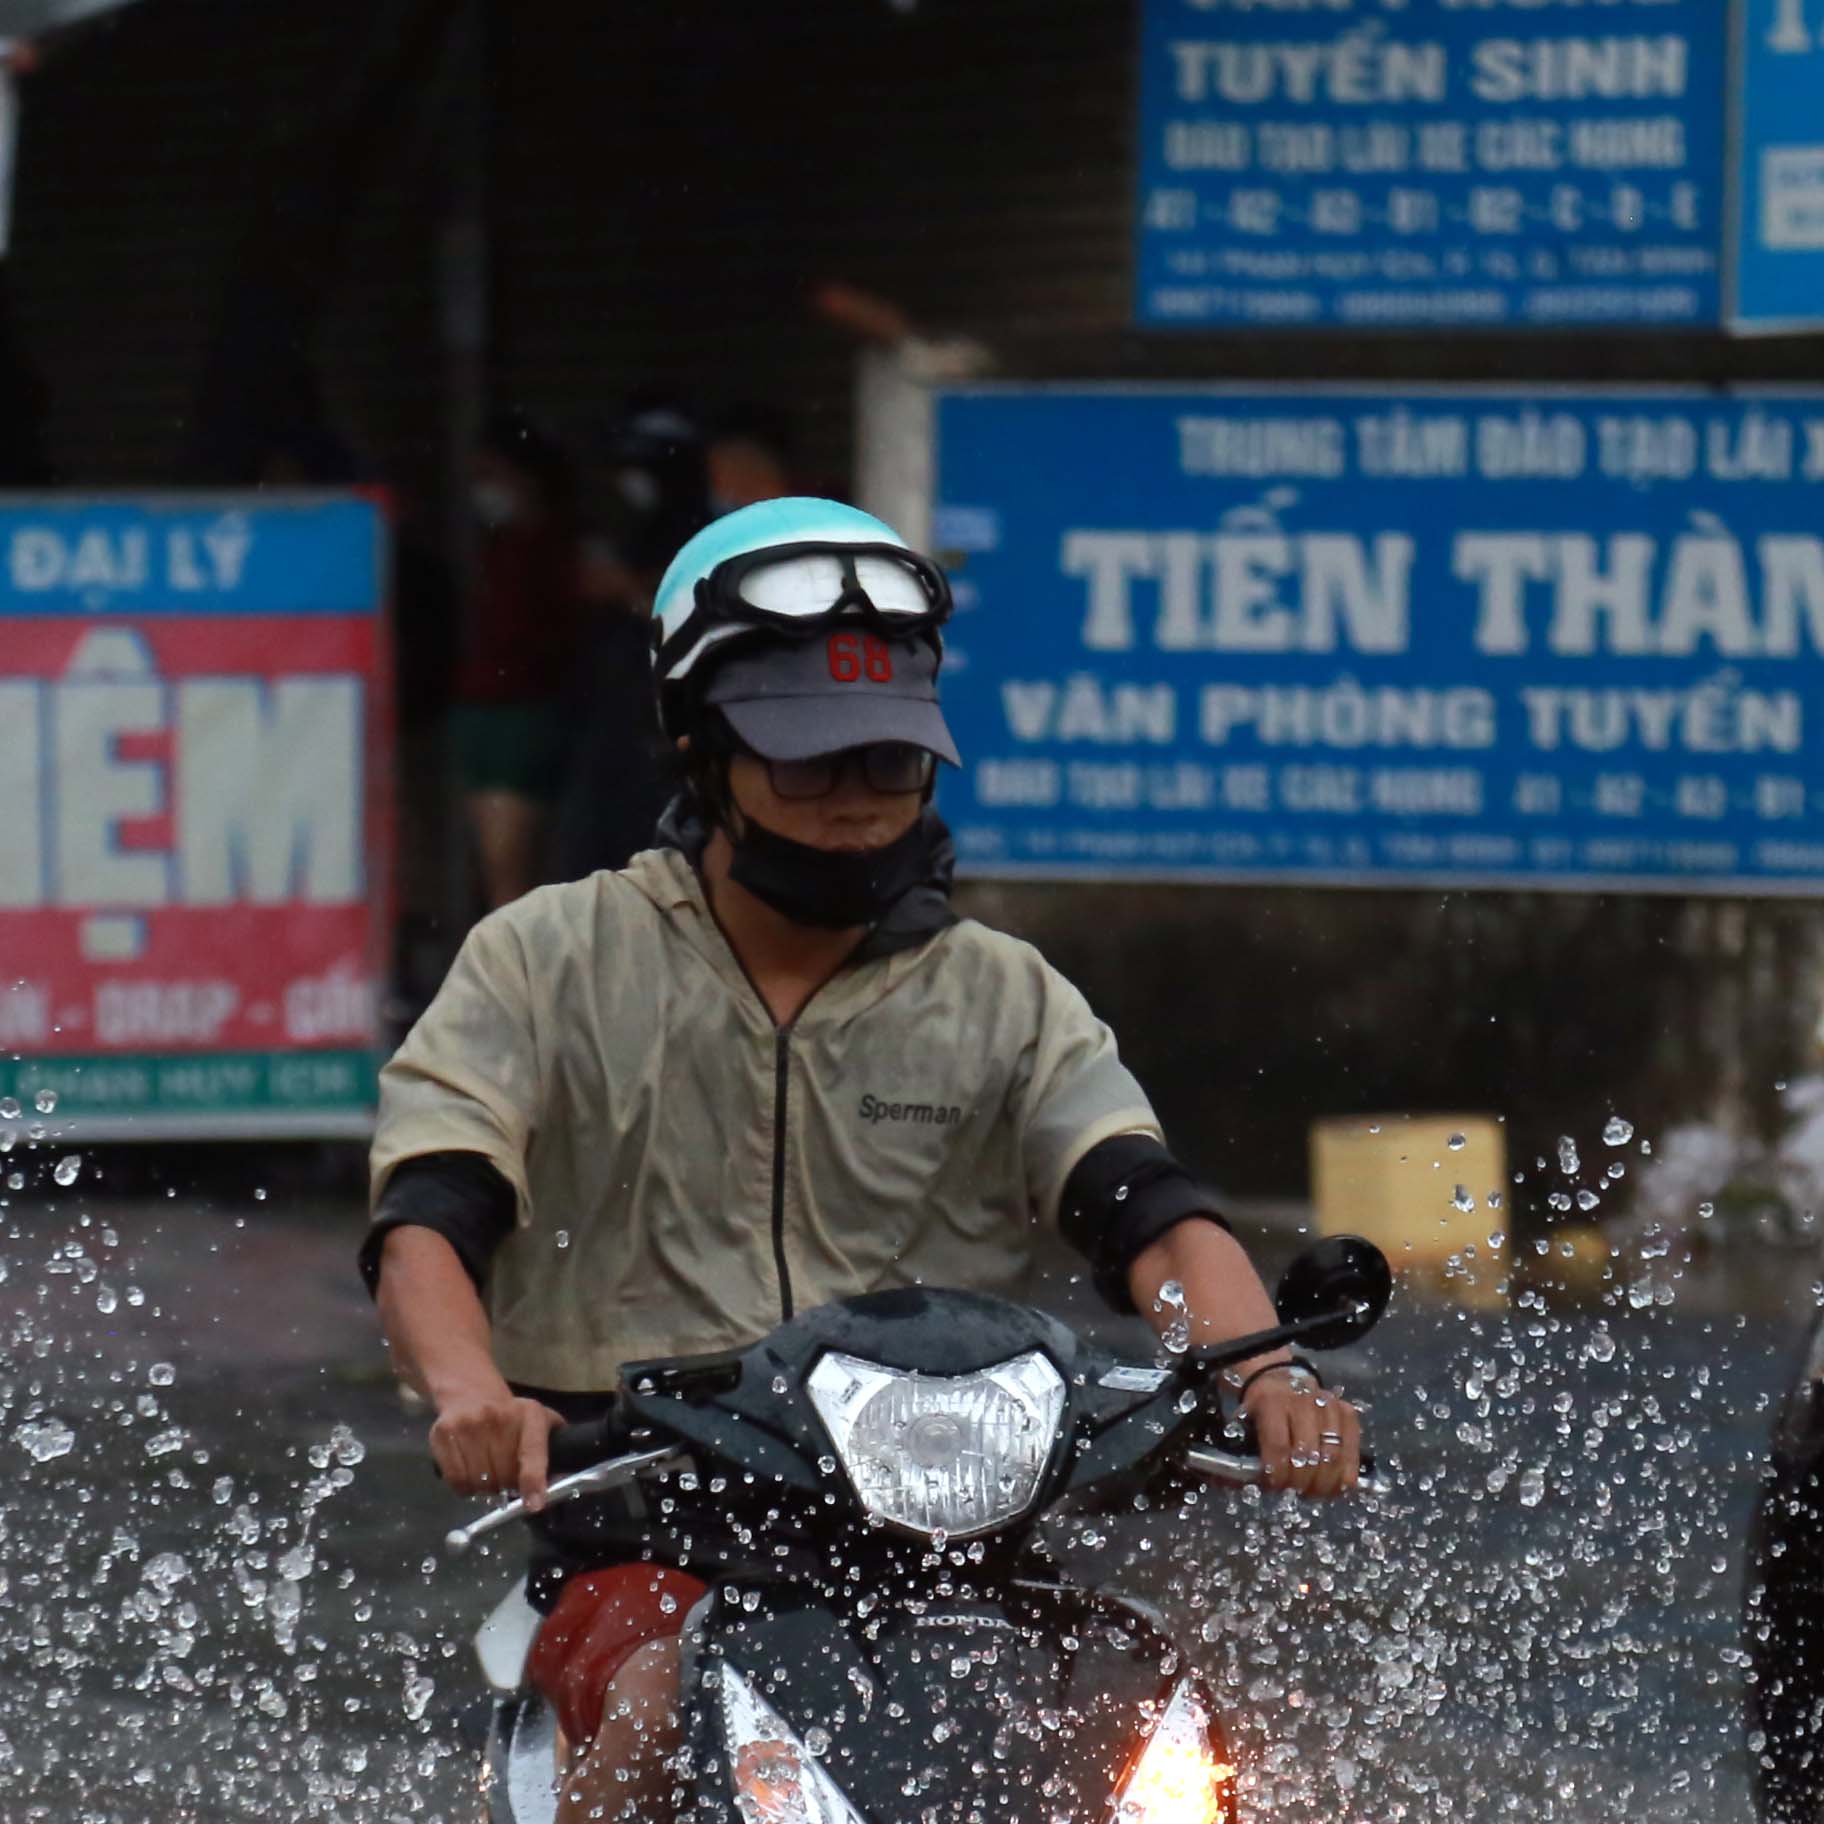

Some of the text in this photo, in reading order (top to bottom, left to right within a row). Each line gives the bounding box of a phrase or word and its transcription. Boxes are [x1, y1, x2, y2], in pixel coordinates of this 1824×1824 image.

[1471, 35, 1687, 100] SINH
[1177, 414, 1344, 477] TRUNG
[1356, 406, 1468, 477] TÂM
[1707, 405, 1794, 481] LÁI
[8, 511, 253, 609] ĐẠI LÝ
[1060, 488, 1415, 655] TIẾN
[827, 632, 893, 683] 68
[1001, 671, 1175, 745] VĂN
[1198, 672, 1495, 749] PHÒNG
[914, 1614, 1015, 1630] HONDA
